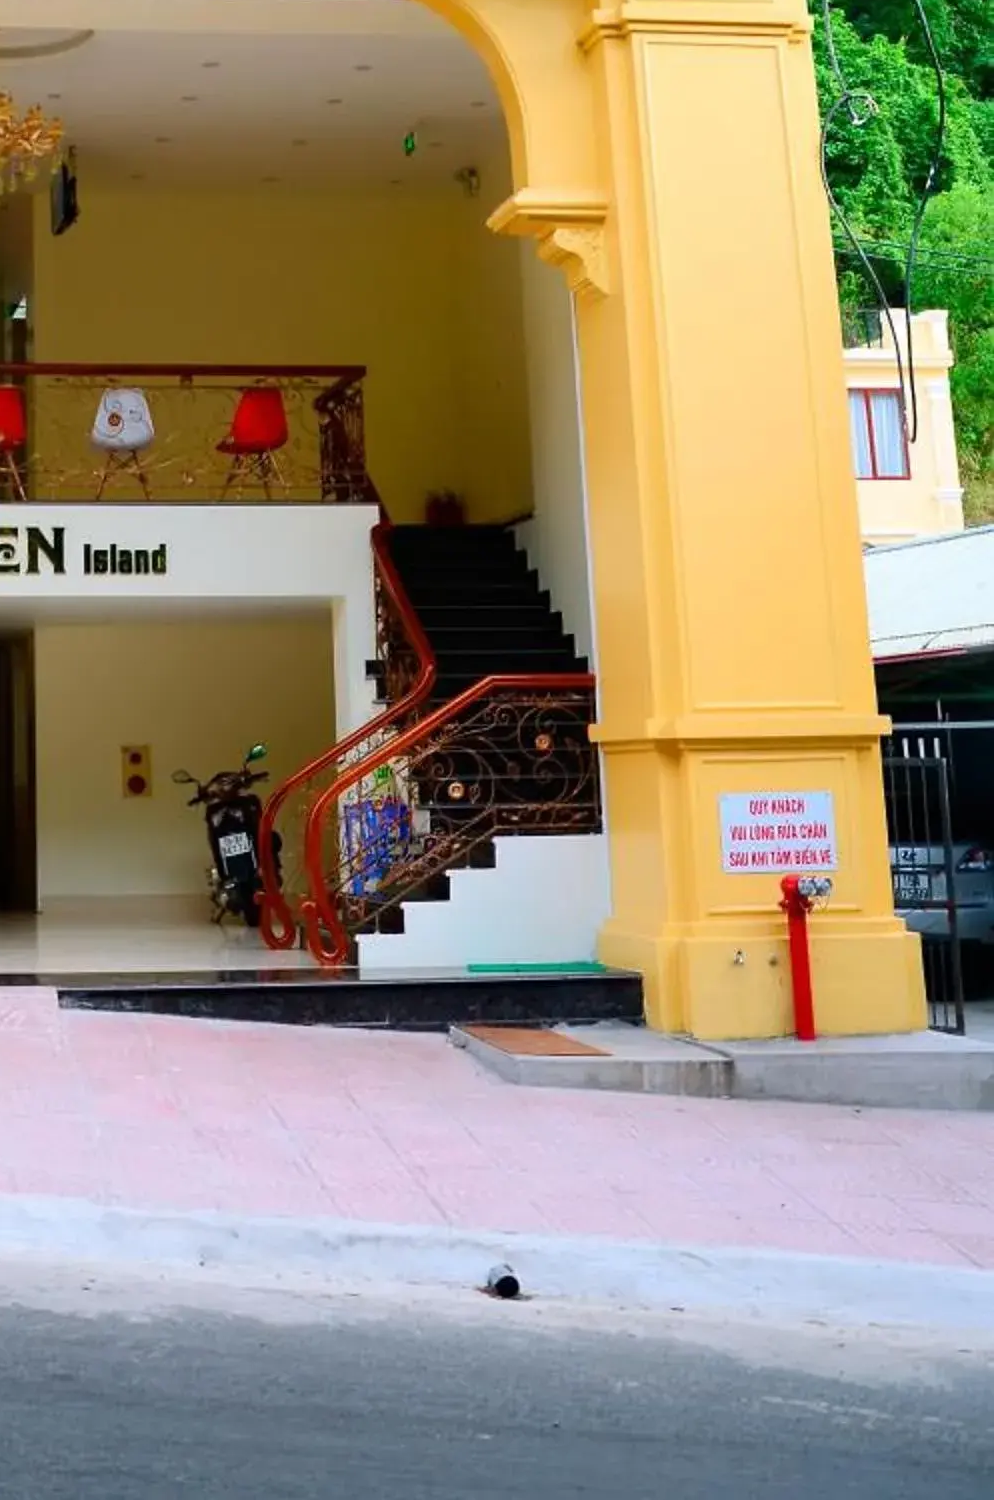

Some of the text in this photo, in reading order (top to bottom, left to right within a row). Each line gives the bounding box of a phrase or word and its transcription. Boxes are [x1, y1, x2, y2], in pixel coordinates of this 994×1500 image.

[83, 543, 167, 575] Island
[730, 825, 747, 840] VUI
[730, 851, 748, 867] SAU
